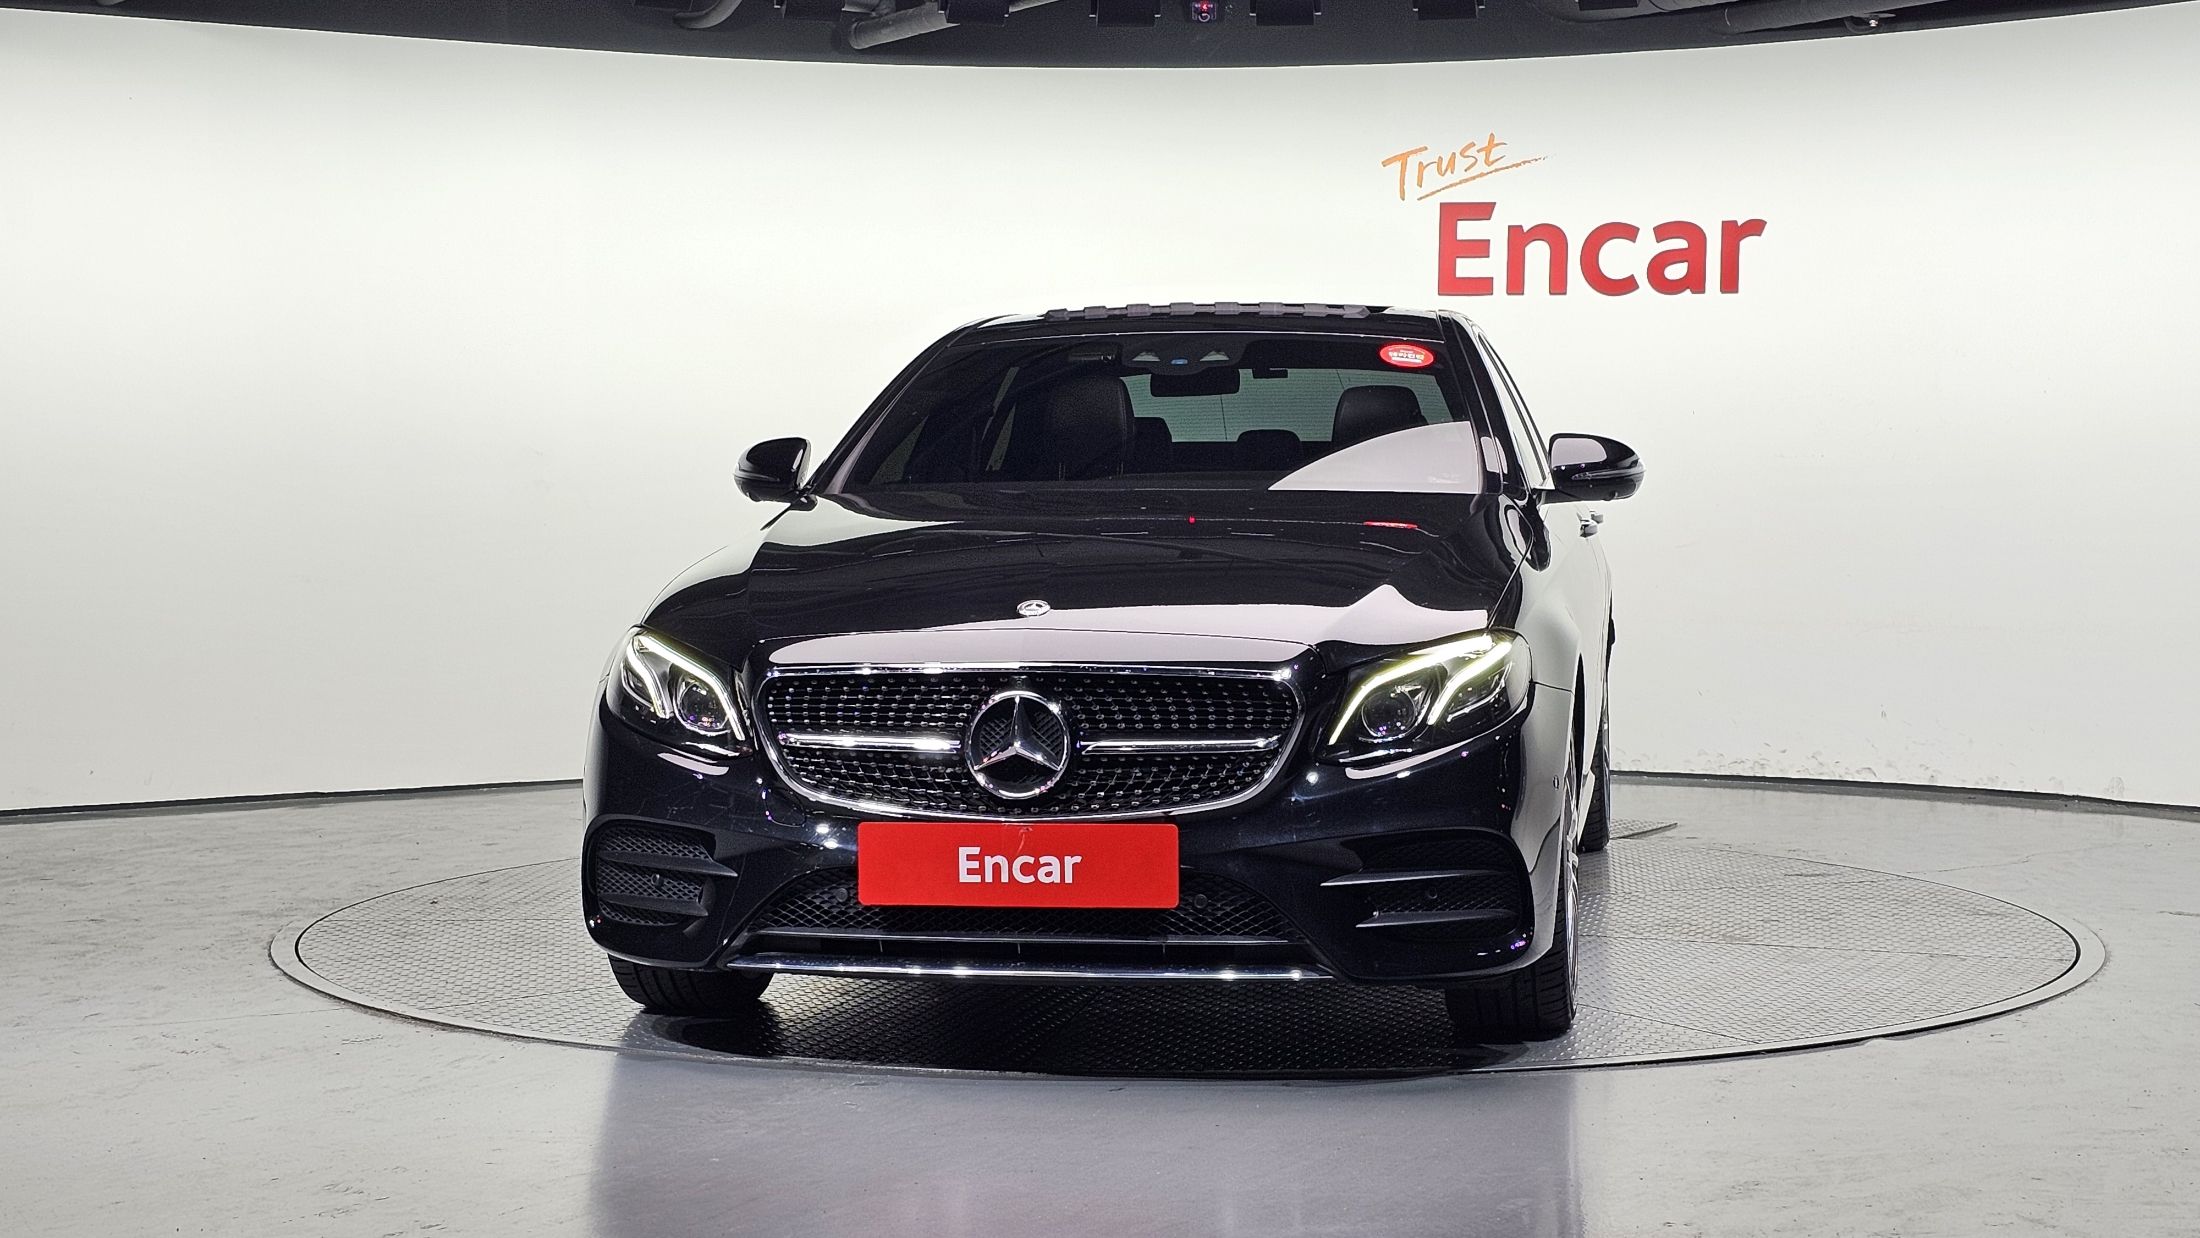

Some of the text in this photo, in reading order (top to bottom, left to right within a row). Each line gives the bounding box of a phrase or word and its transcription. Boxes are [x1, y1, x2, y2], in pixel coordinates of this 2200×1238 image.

[1381, 132, 1508, 201] Trust
[1437, 201, 1768, 296] Encar
[957, 846, 1083, 884] Encar
